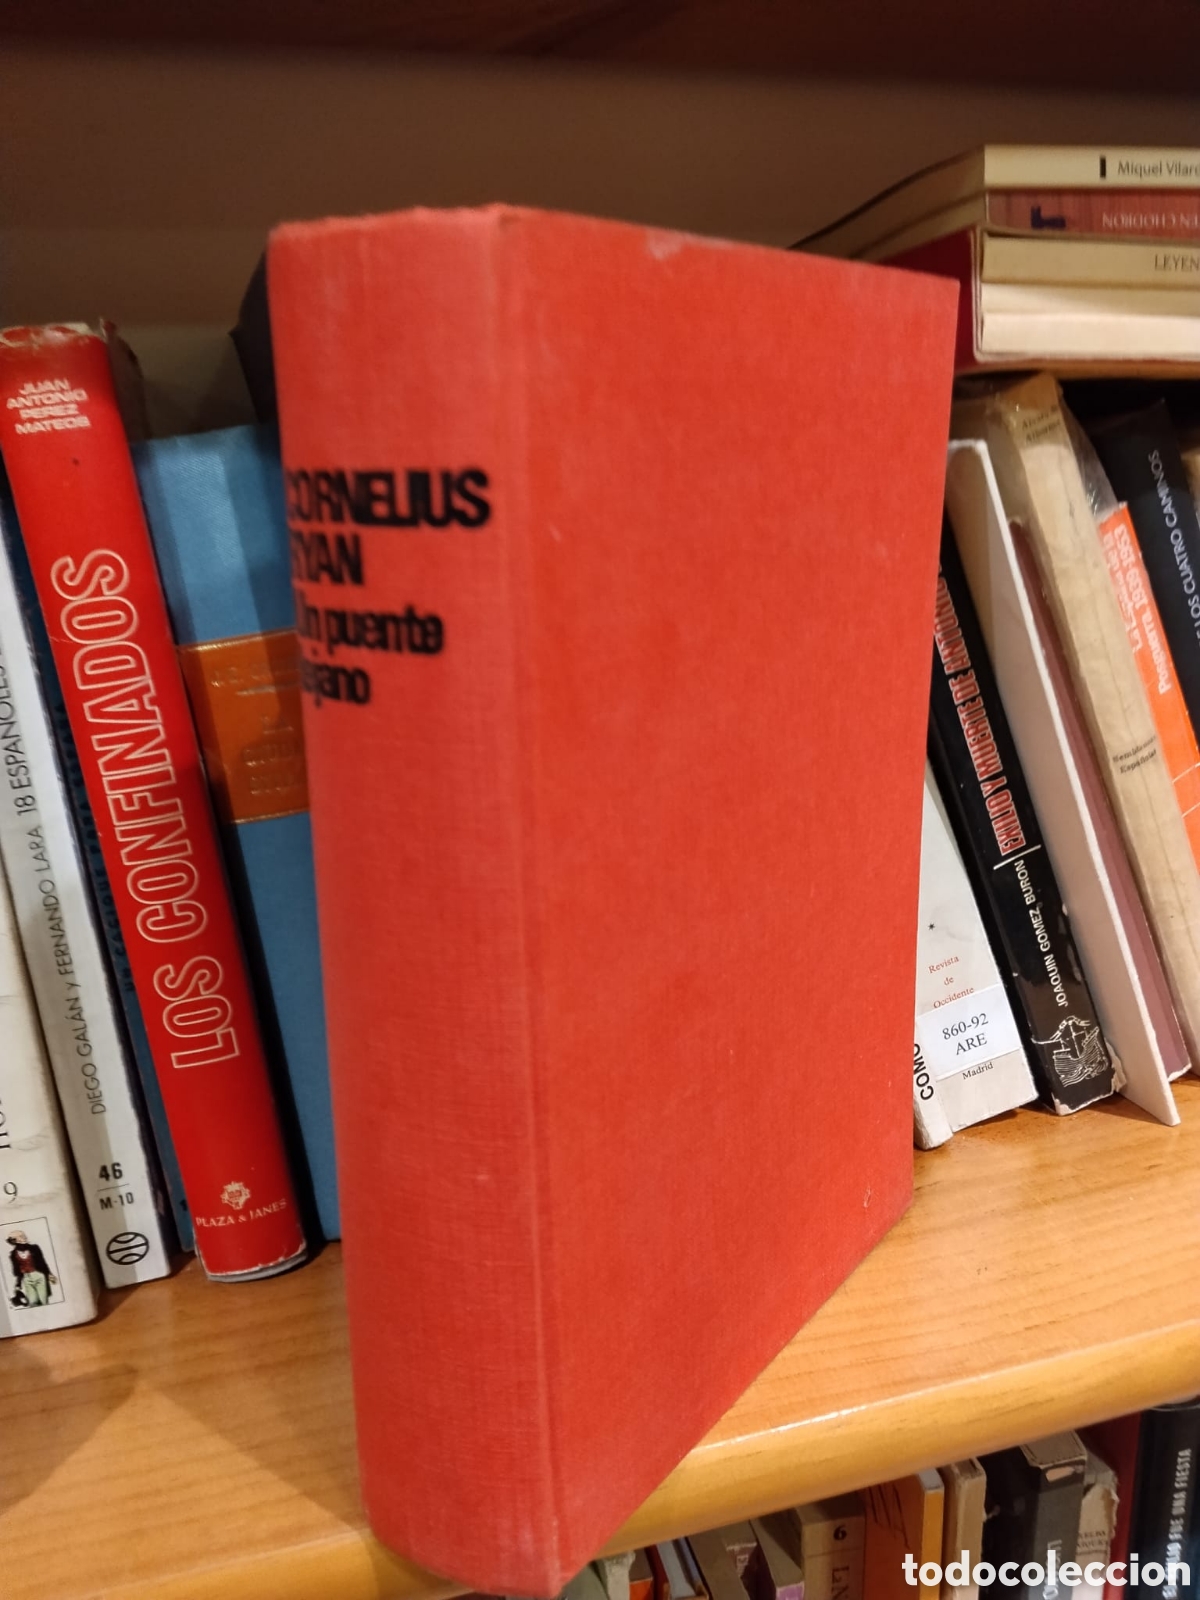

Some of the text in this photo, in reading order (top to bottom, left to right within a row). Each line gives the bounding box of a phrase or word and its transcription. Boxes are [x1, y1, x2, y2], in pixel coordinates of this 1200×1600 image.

[1118, 160, 1163, 178] Miquel
[6, 388, 88, 409] ANTONIO
[18, 378, 71, 395] JUAN
[15, 415, 91, 435] MATEOS
[1148, 450, 1177, 528] CAMINOS
[291, 530, 364, 585] YAN
[1170, 528, 1196, 594] CUATRO
[323, 603, 444, 656] puente
[949, 668, 981, 705] DE
[956, 695, 1004, 781] MUERTE
[981, 776, 1007, 799] Y
[14, 795, 37, 816] 18
[51, 548, 241, 1069] LOS CONFINADOS
[985, 788, 1027, 856] EXILIO
[27, 825, 51, 873] LARA
[39, 880, 75, 976] FERNANDO
[1014, 859, 1069, 1007] JOAQUIN GOMEZ BURON
[928, 956, 960, 974] Revista
[943, 976, 954, 986] de
[933, 986, 975, 1009] Occidente
[65, 997, 93, 1057] GALÁN
[942, 1013, 989, 1040] 860-92
[956, 1033, 988, 1055] ARE
[962, 1061, 994, 1080] Madrid
[82, 1063, 107, 1115] DIEGO
[99, 1162, 123, 1181] 46
[195, 1215, 235, 1228] PLAZA
[833, 1524, 848, 1541] 6
